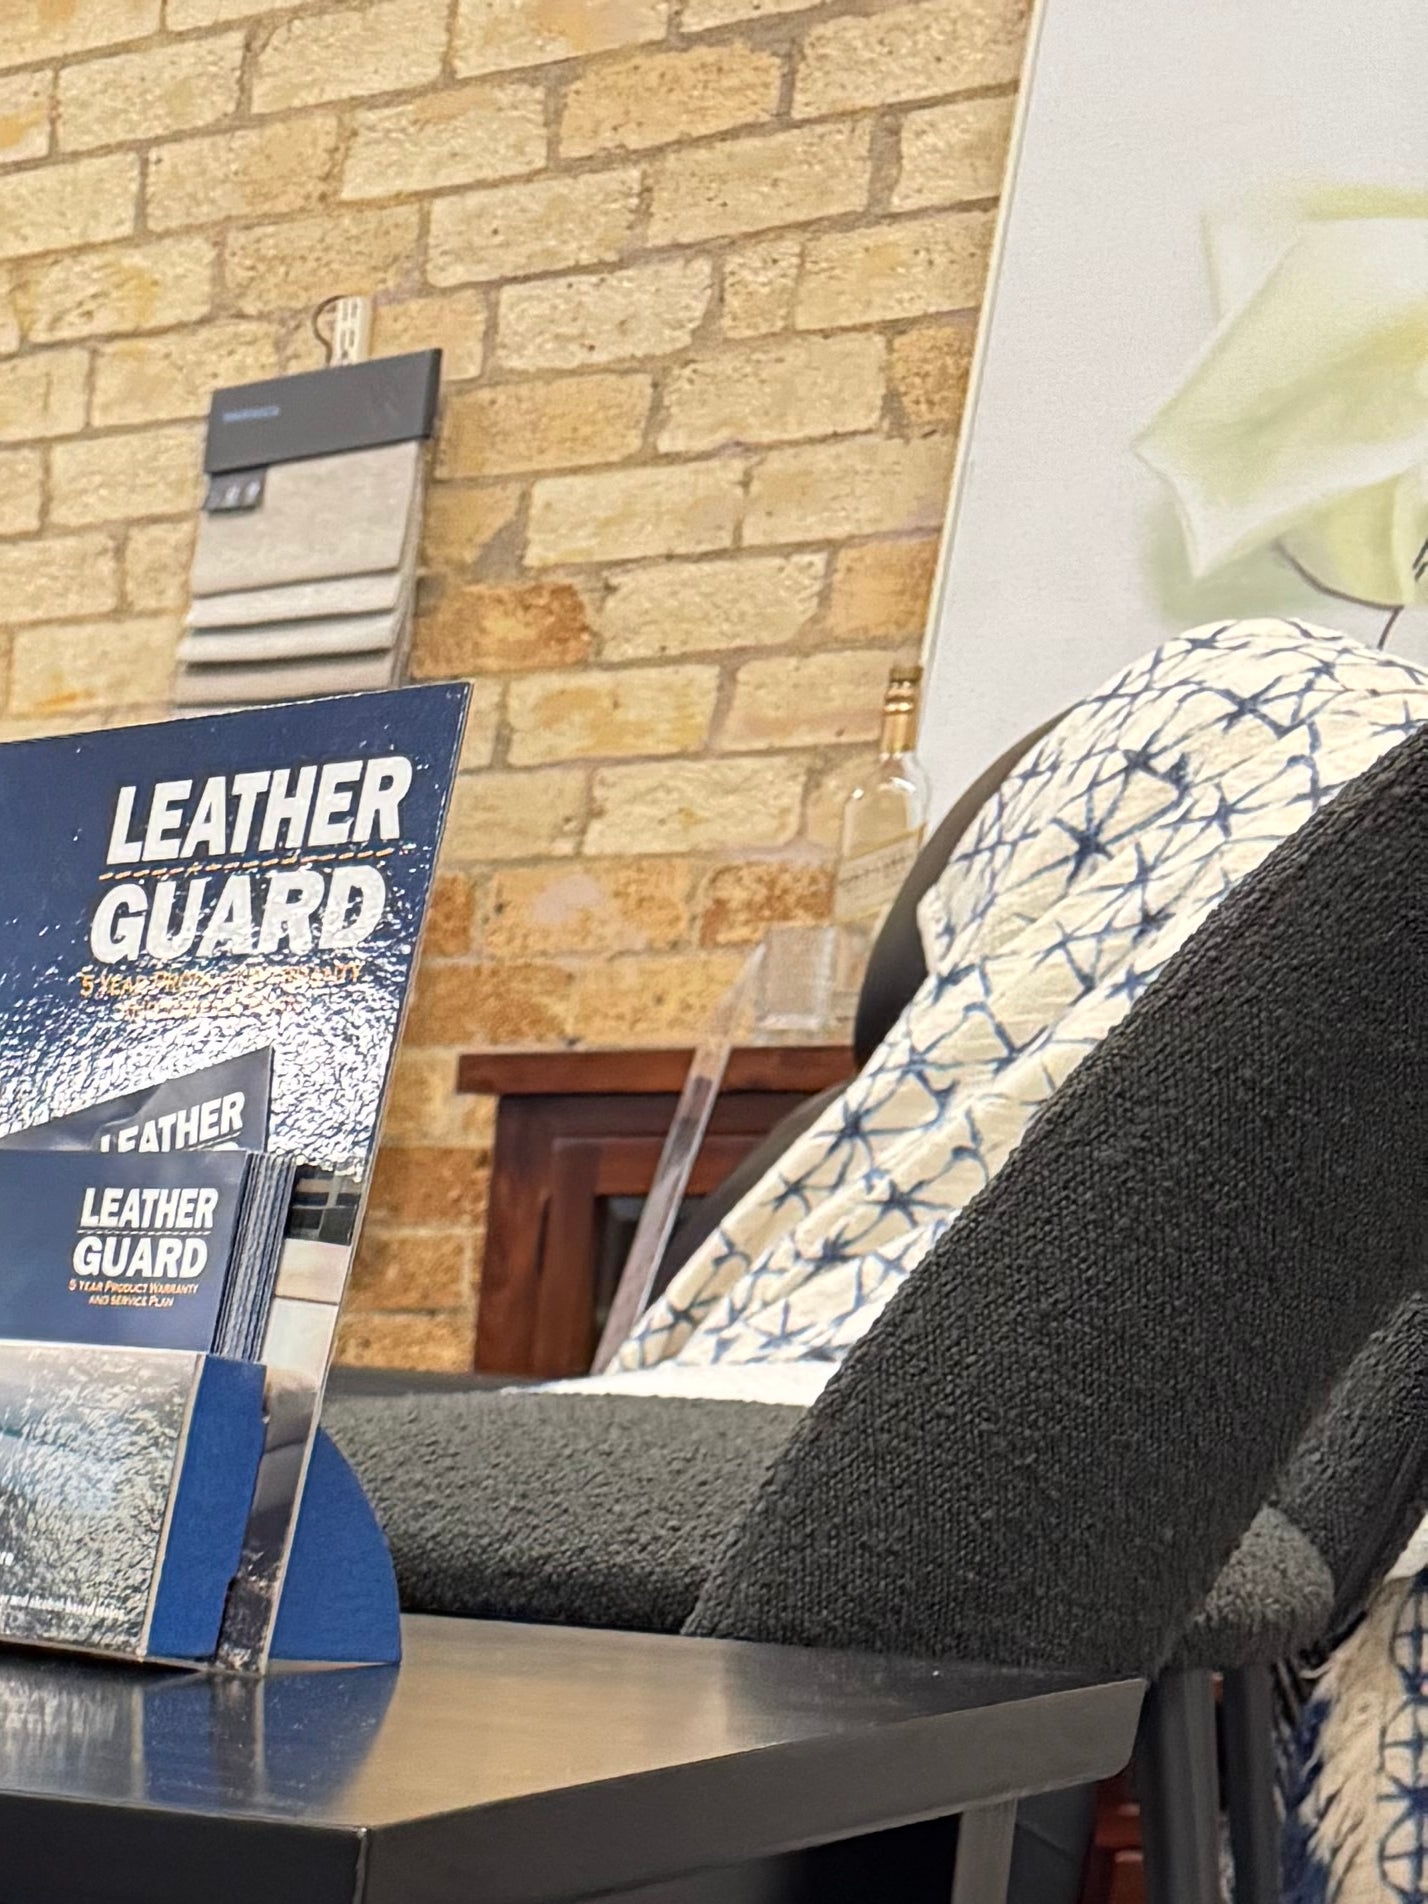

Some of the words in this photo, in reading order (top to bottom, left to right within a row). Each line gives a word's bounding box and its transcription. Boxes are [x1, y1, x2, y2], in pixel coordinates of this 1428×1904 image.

[106, 755, 413, 866] LEATHER
[90, 864, 387, 964] GUARD
[80, 1187, 219, 1229] LEATHER
[72, 1235, 208, 1279] GUARD
[68, 1279, 77, 1291] 5
[79, 1280, 104, 1292] YEAR
[105, 1280, 148, 1294] PRODUCT
[149, 1282, 199, 1295] WARRANTY
[148, 1295, 175, 1308] PLAN
